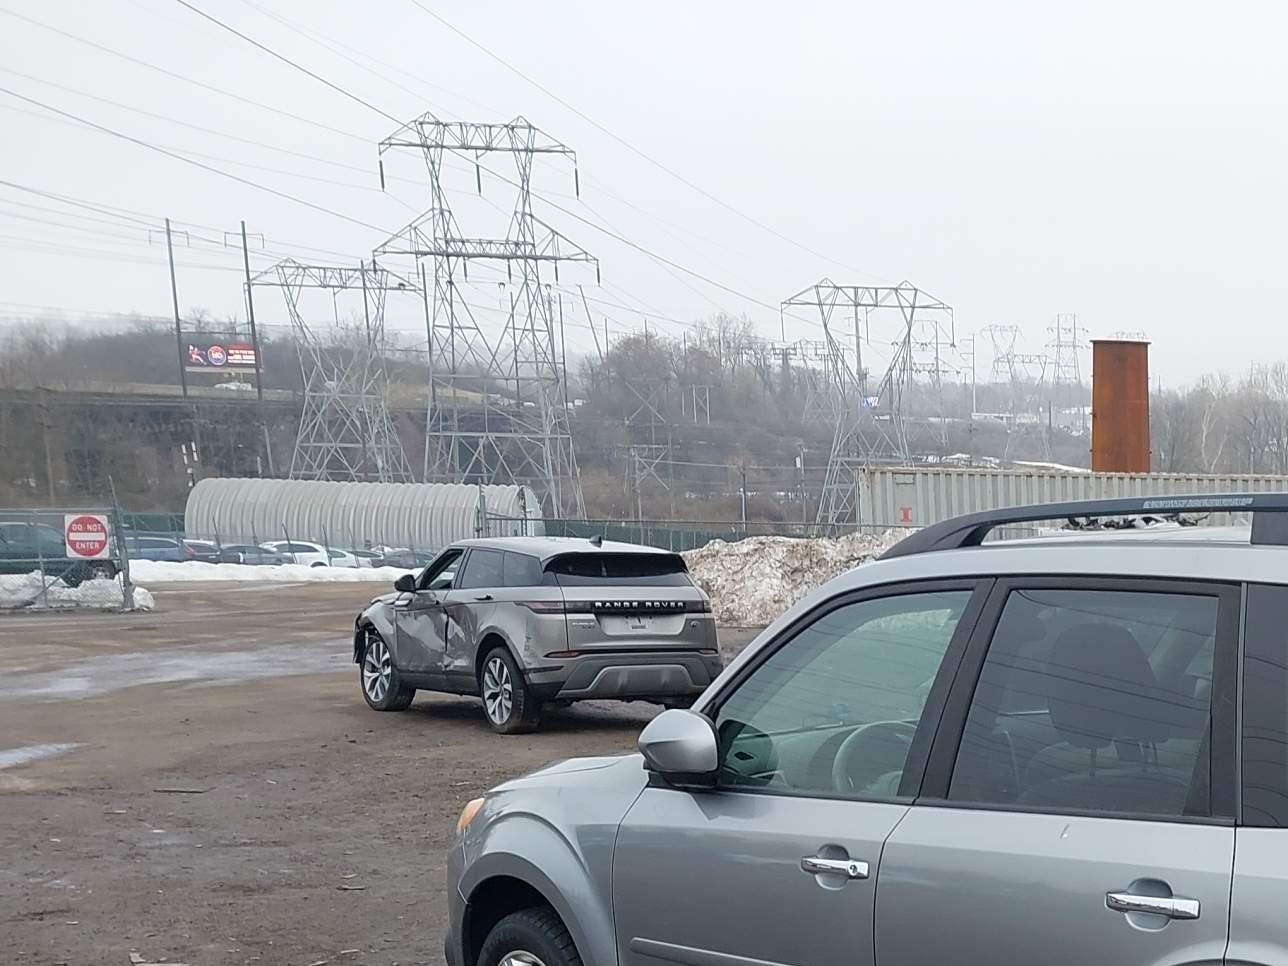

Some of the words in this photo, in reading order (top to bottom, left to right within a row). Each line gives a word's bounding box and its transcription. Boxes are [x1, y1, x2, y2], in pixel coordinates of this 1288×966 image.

[71, 523, 83, 531] DO
[86, 523, 102, 531] NOT
[75, 541, 100, 550] ENTER
[594, 601, 639, 609] RANGE
